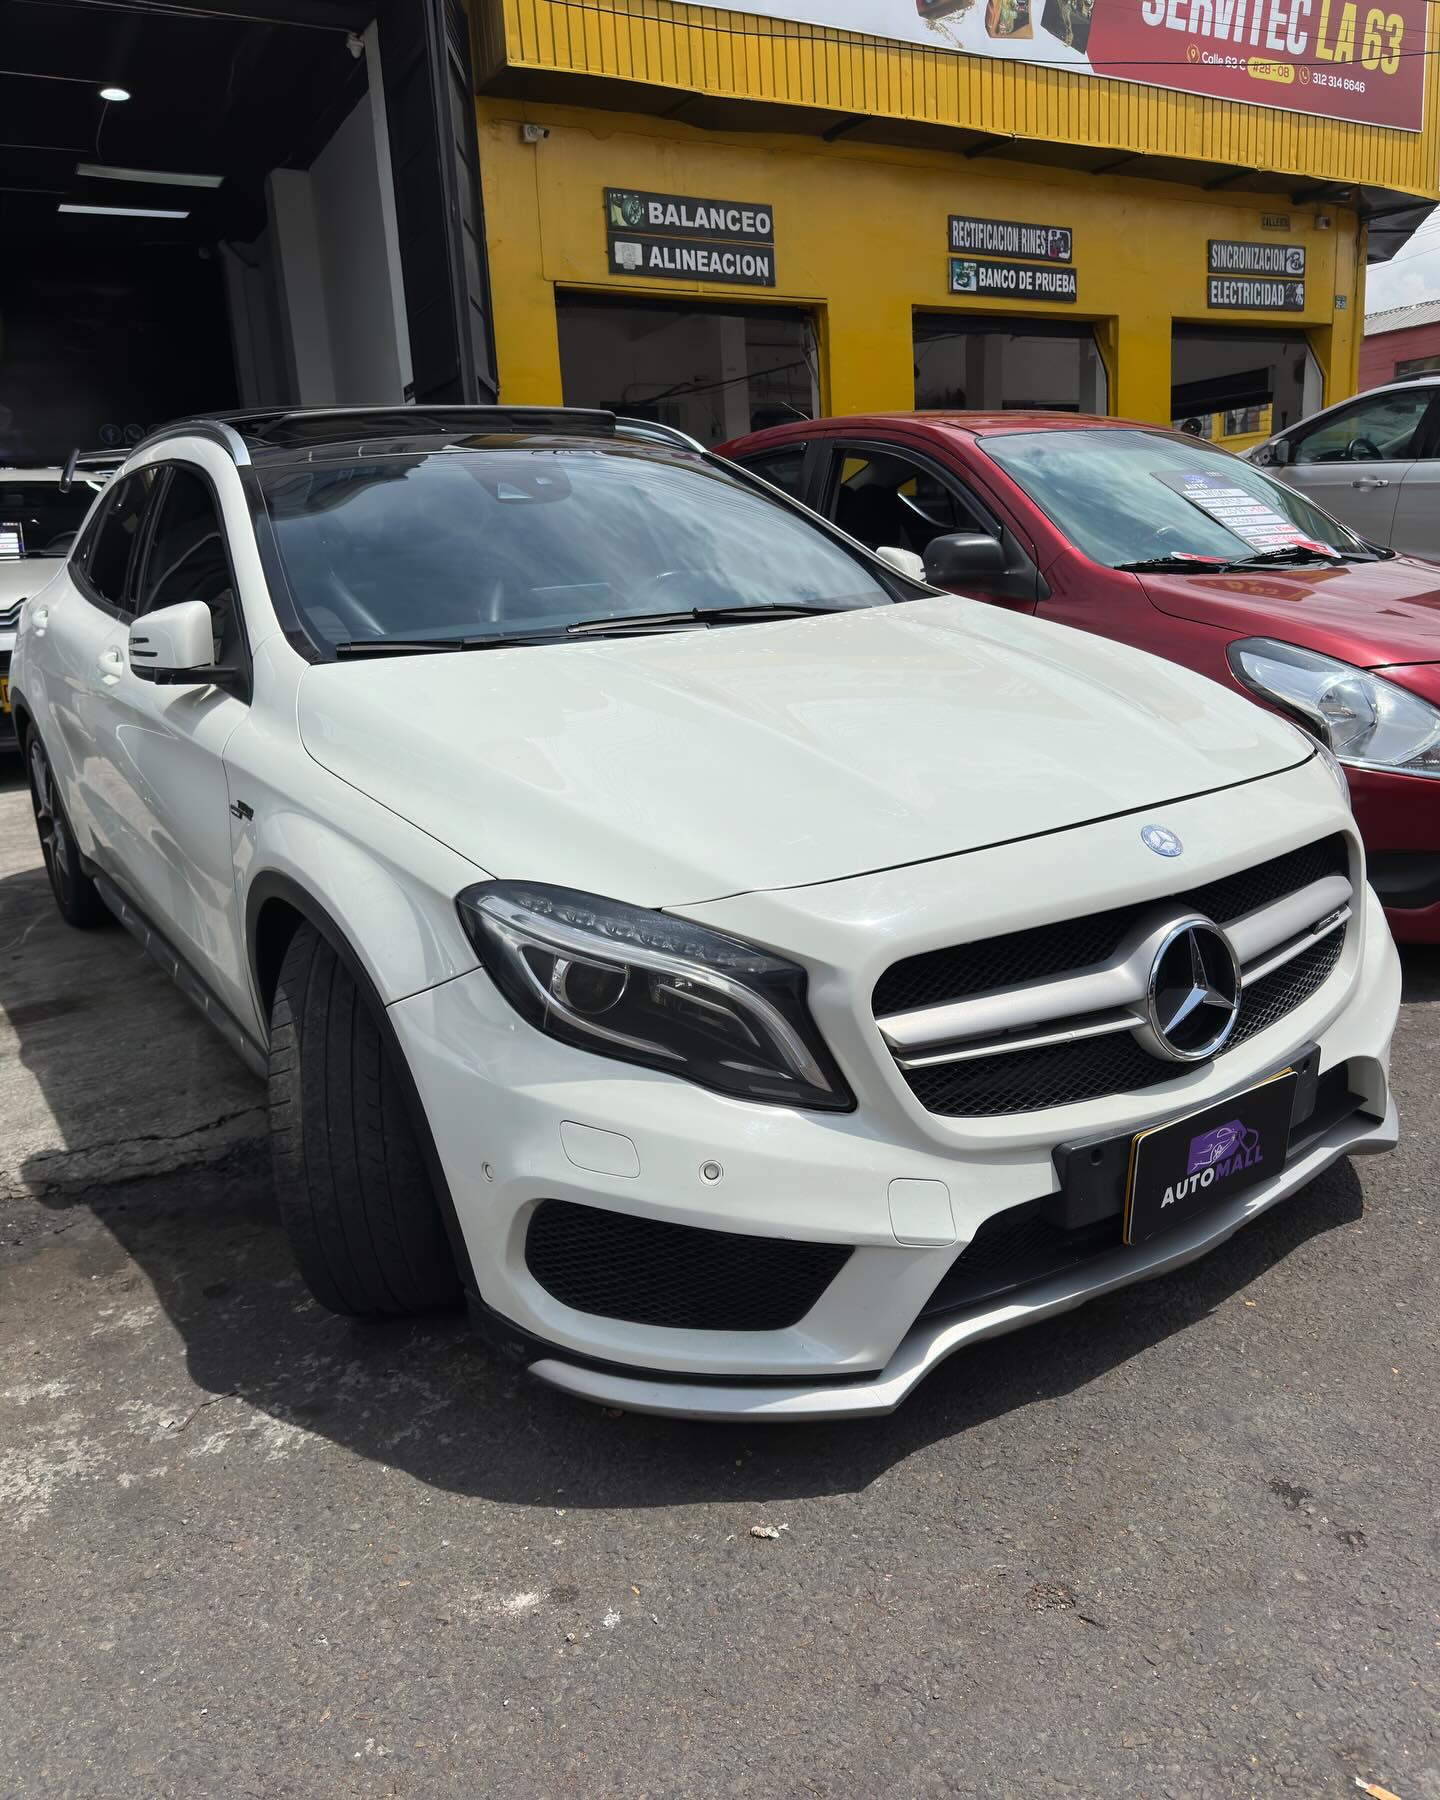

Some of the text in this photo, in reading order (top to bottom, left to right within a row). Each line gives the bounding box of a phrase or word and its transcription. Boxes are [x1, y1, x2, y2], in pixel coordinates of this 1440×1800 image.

[1315, 0, 1358, 65] LA
[1361, 8, 1404, 75] 63
[1201, 51, 1224, 66] Calle
[1225, 55, 1238, 69] 63
[1312, 72, 1327, 86] 312
[1328, 75, 1343, 89] 314
[1343, 78, 1366, 93] 6646
[648, 202, 771, 234] BALANCEO
[952, 220, 1046, 255] RECTIFICACION RINES
[649, 246, 769, 278] ALINEACION
[1211, 244, 1286, 272] SINCRONIZACION
[978, 267, 1076, 294] BANCO DE PRUEBA
[1211, 281, 1285, 306] ELECTRICIDAD
[1160, 1144, 1263, 1209] AUTOMALL
